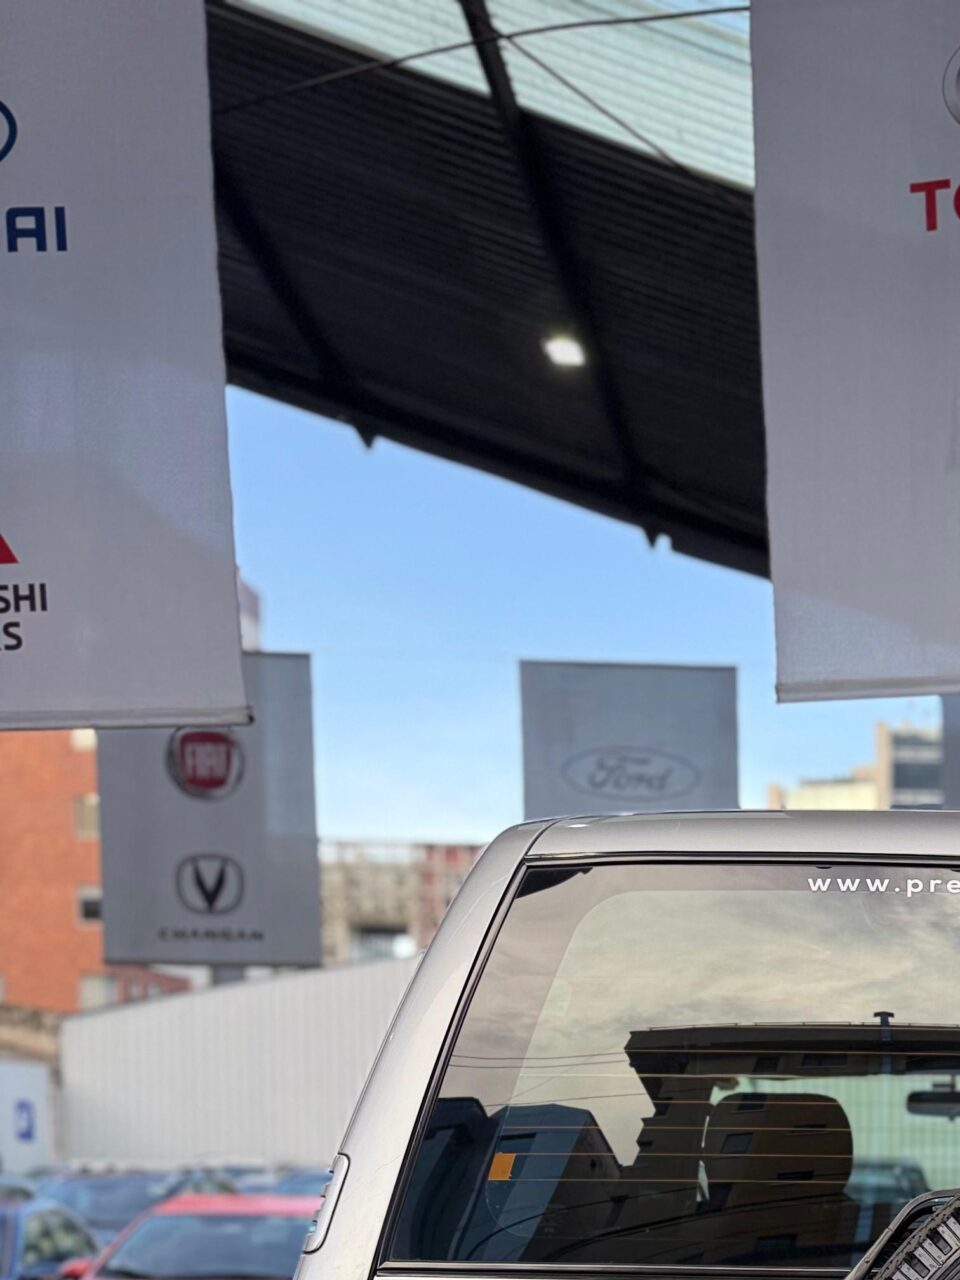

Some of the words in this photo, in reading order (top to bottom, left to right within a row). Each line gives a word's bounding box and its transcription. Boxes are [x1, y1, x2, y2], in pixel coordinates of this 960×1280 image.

[184, 740, 232, 780] FIAT
[588, 756, 675, 791] Ford
[157, 926, 264, 942] CHANGAN
